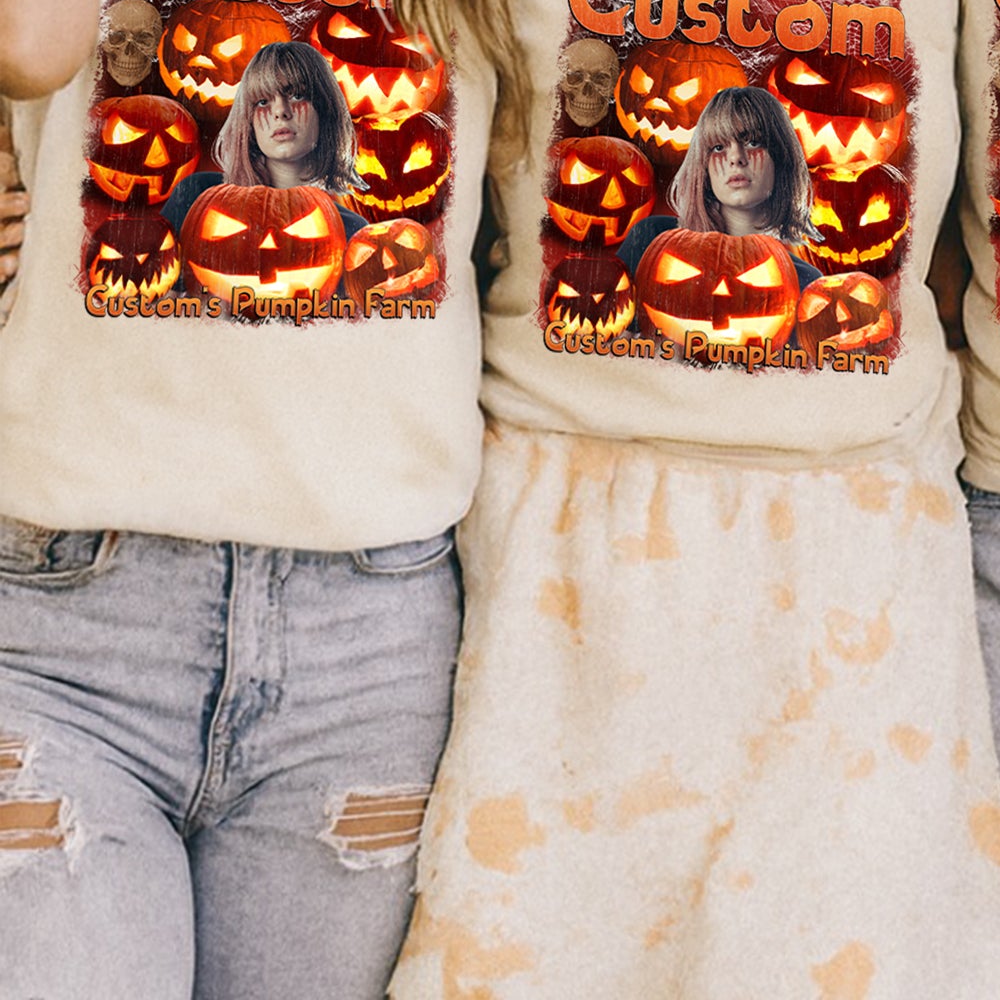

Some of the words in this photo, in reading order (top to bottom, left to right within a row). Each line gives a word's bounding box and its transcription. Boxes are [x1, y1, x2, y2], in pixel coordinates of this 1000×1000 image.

[85, 284, 221, 319] Custom's
[231, 286, 355, 325] Pumpkin
[364, 289, 437, 320] Farm
[543, 320, 675, 360] Custom's
[684, 330, 807, 374] Pumpkin
[815, 339, 890, 376] Farm
